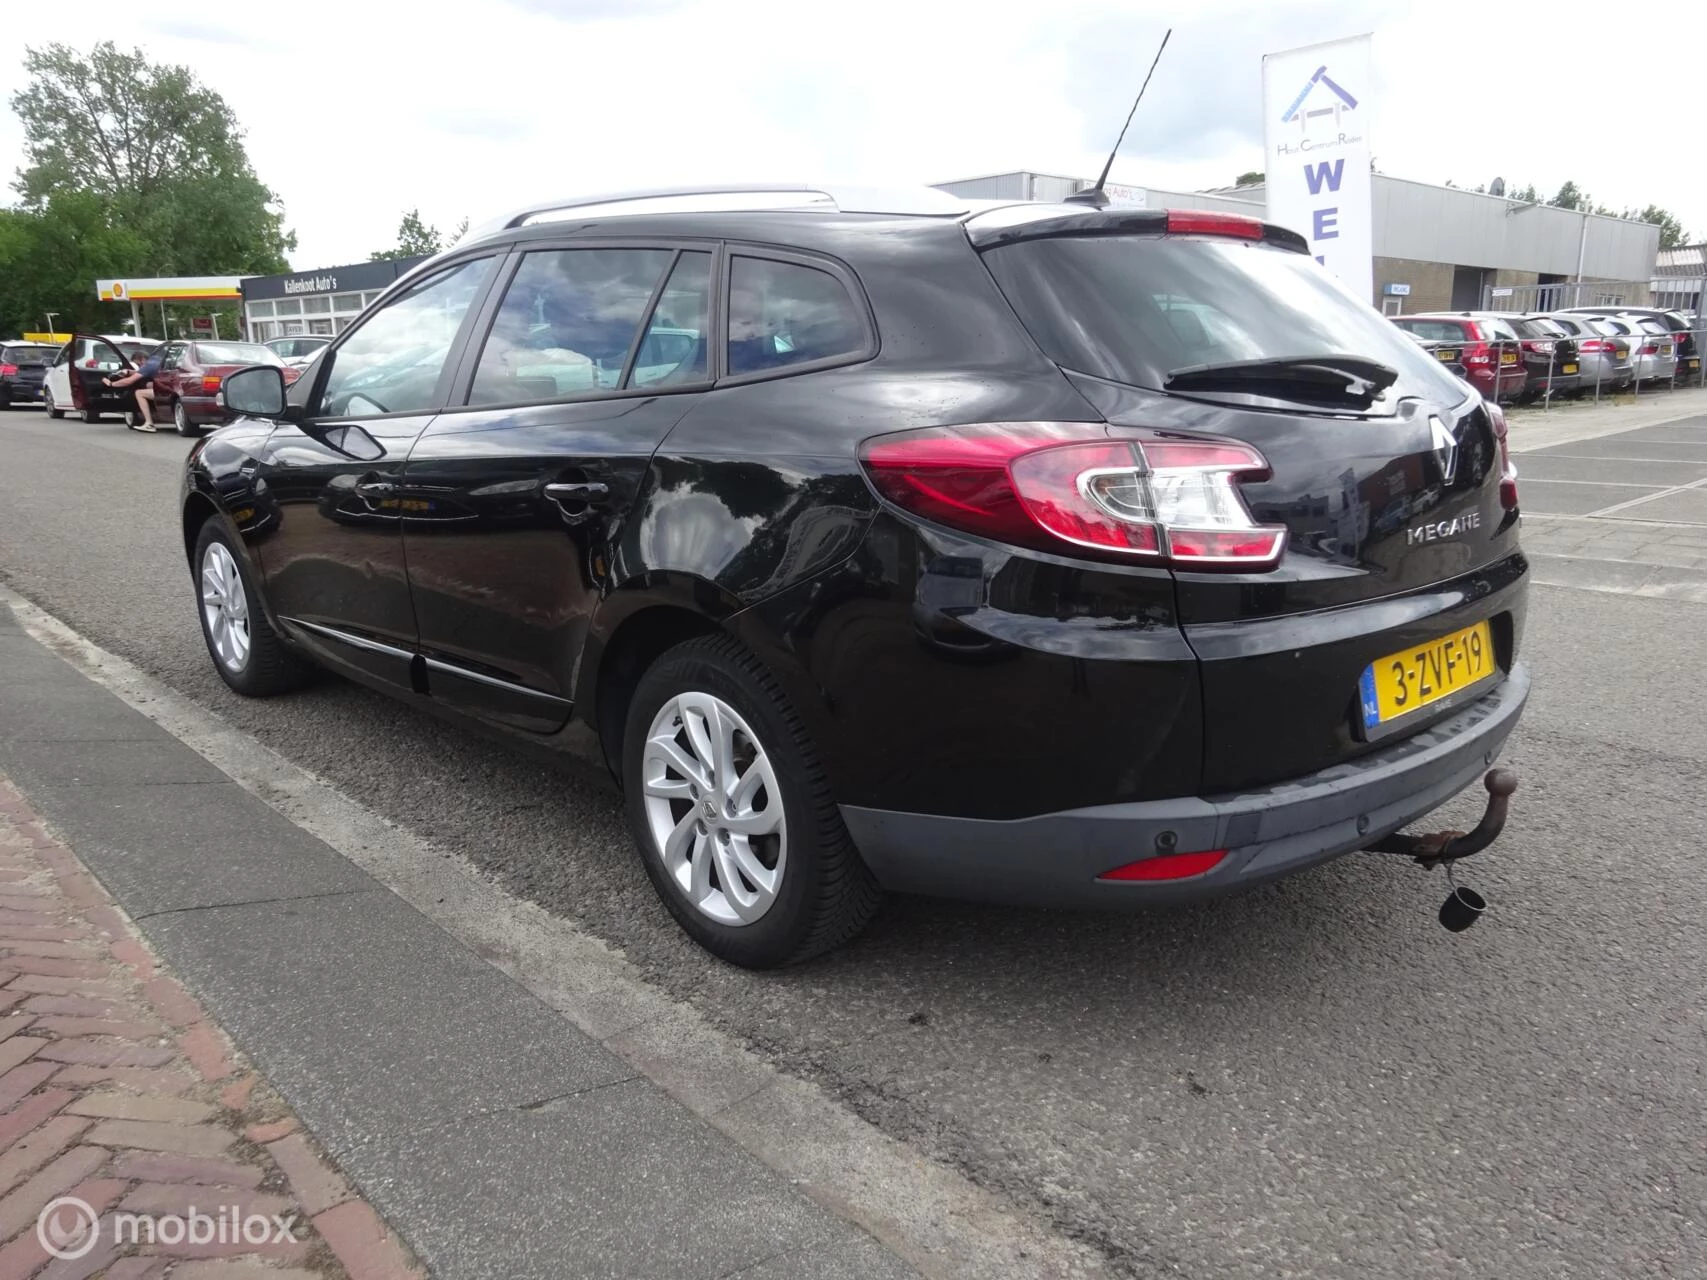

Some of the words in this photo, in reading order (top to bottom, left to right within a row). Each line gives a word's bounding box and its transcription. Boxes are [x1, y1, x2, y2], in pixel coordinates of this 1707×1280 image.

[315, 275, 337, 291] Auto's
[1407, 513, 1480, 545] MEGANE
[1391, 630, 1482, 706] 3-ZVF-19
[1364, 702, 1378, 717] NL
